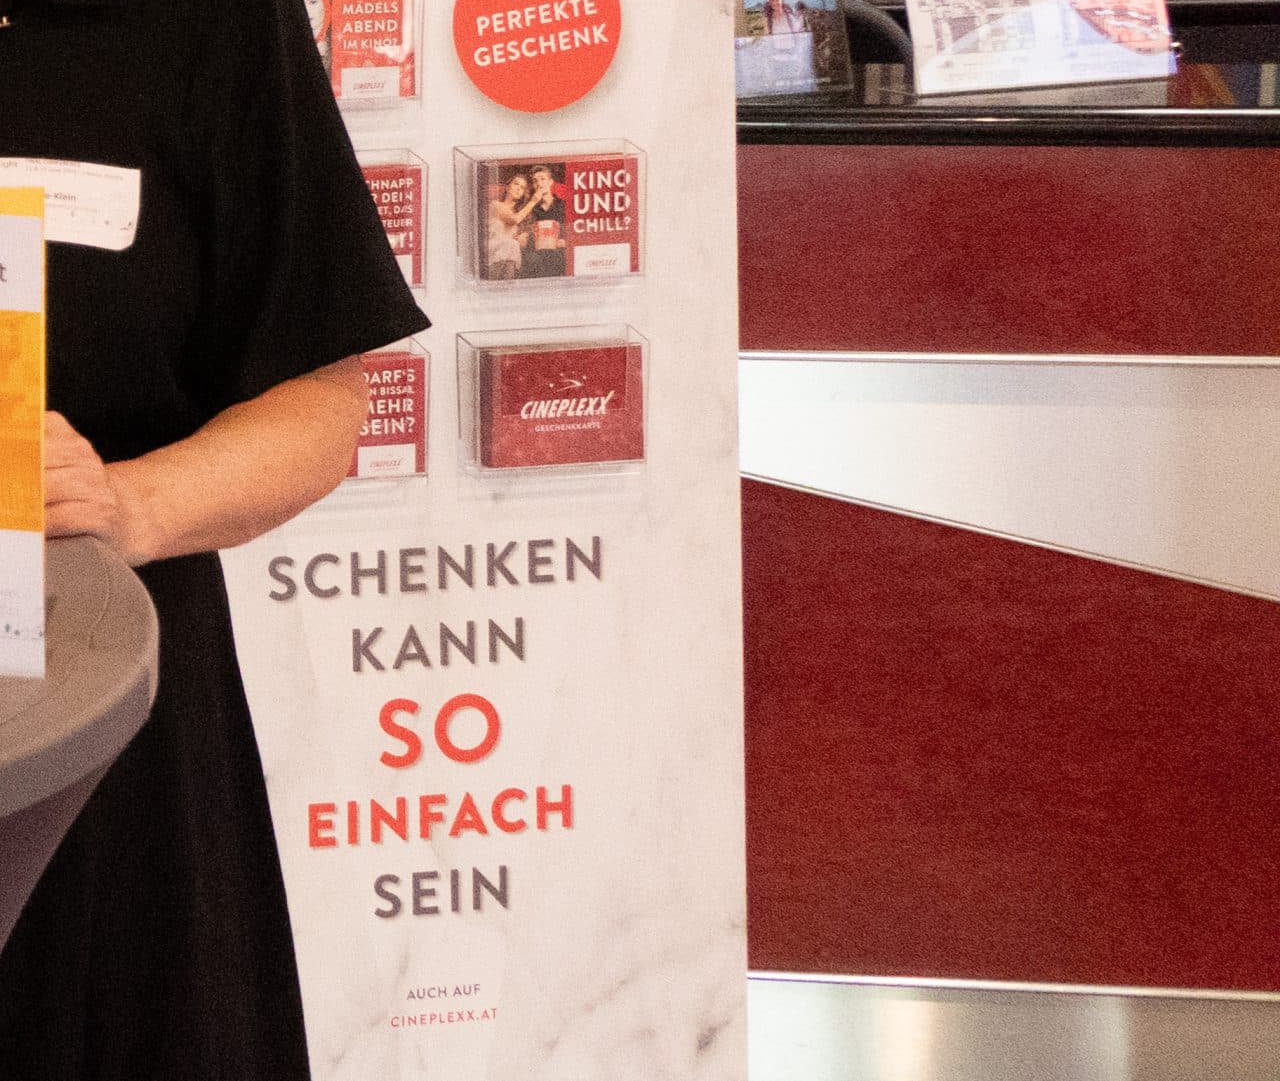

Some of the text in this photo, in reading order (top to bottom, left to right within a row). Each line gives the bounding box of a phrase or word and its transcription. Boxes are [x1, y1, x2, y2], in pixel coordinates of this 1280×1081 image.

[342, 1, 398, 15] MÄDELS
[342, 20, 398, 33] ABEND
[343, 40, 358, 49] IM
[473, 23, 608, 67] GESCHENK
[365, 178, 414, 190] HNAPP
[573, 169, 631, 190] KINO
[573, 191, 631, 214] UND
[573, 217, 631, 233] CHILL?
[521, 390, 615, 419] CINEPLEXX
[359, 417, 416, 436] SEIN?
[268, 536, 604, 602] SCHENKEN
[351, 617, 527, 672] KANN
[378, 693, 502, 769] SO
[308, 784, 574, 849] EINFACH
[374, 866, 510, 919] SEIN
[407, 984, 481, 1001] AUCH AUF
[390, 1008, 498, 1028] CINEPLEXX.AT
